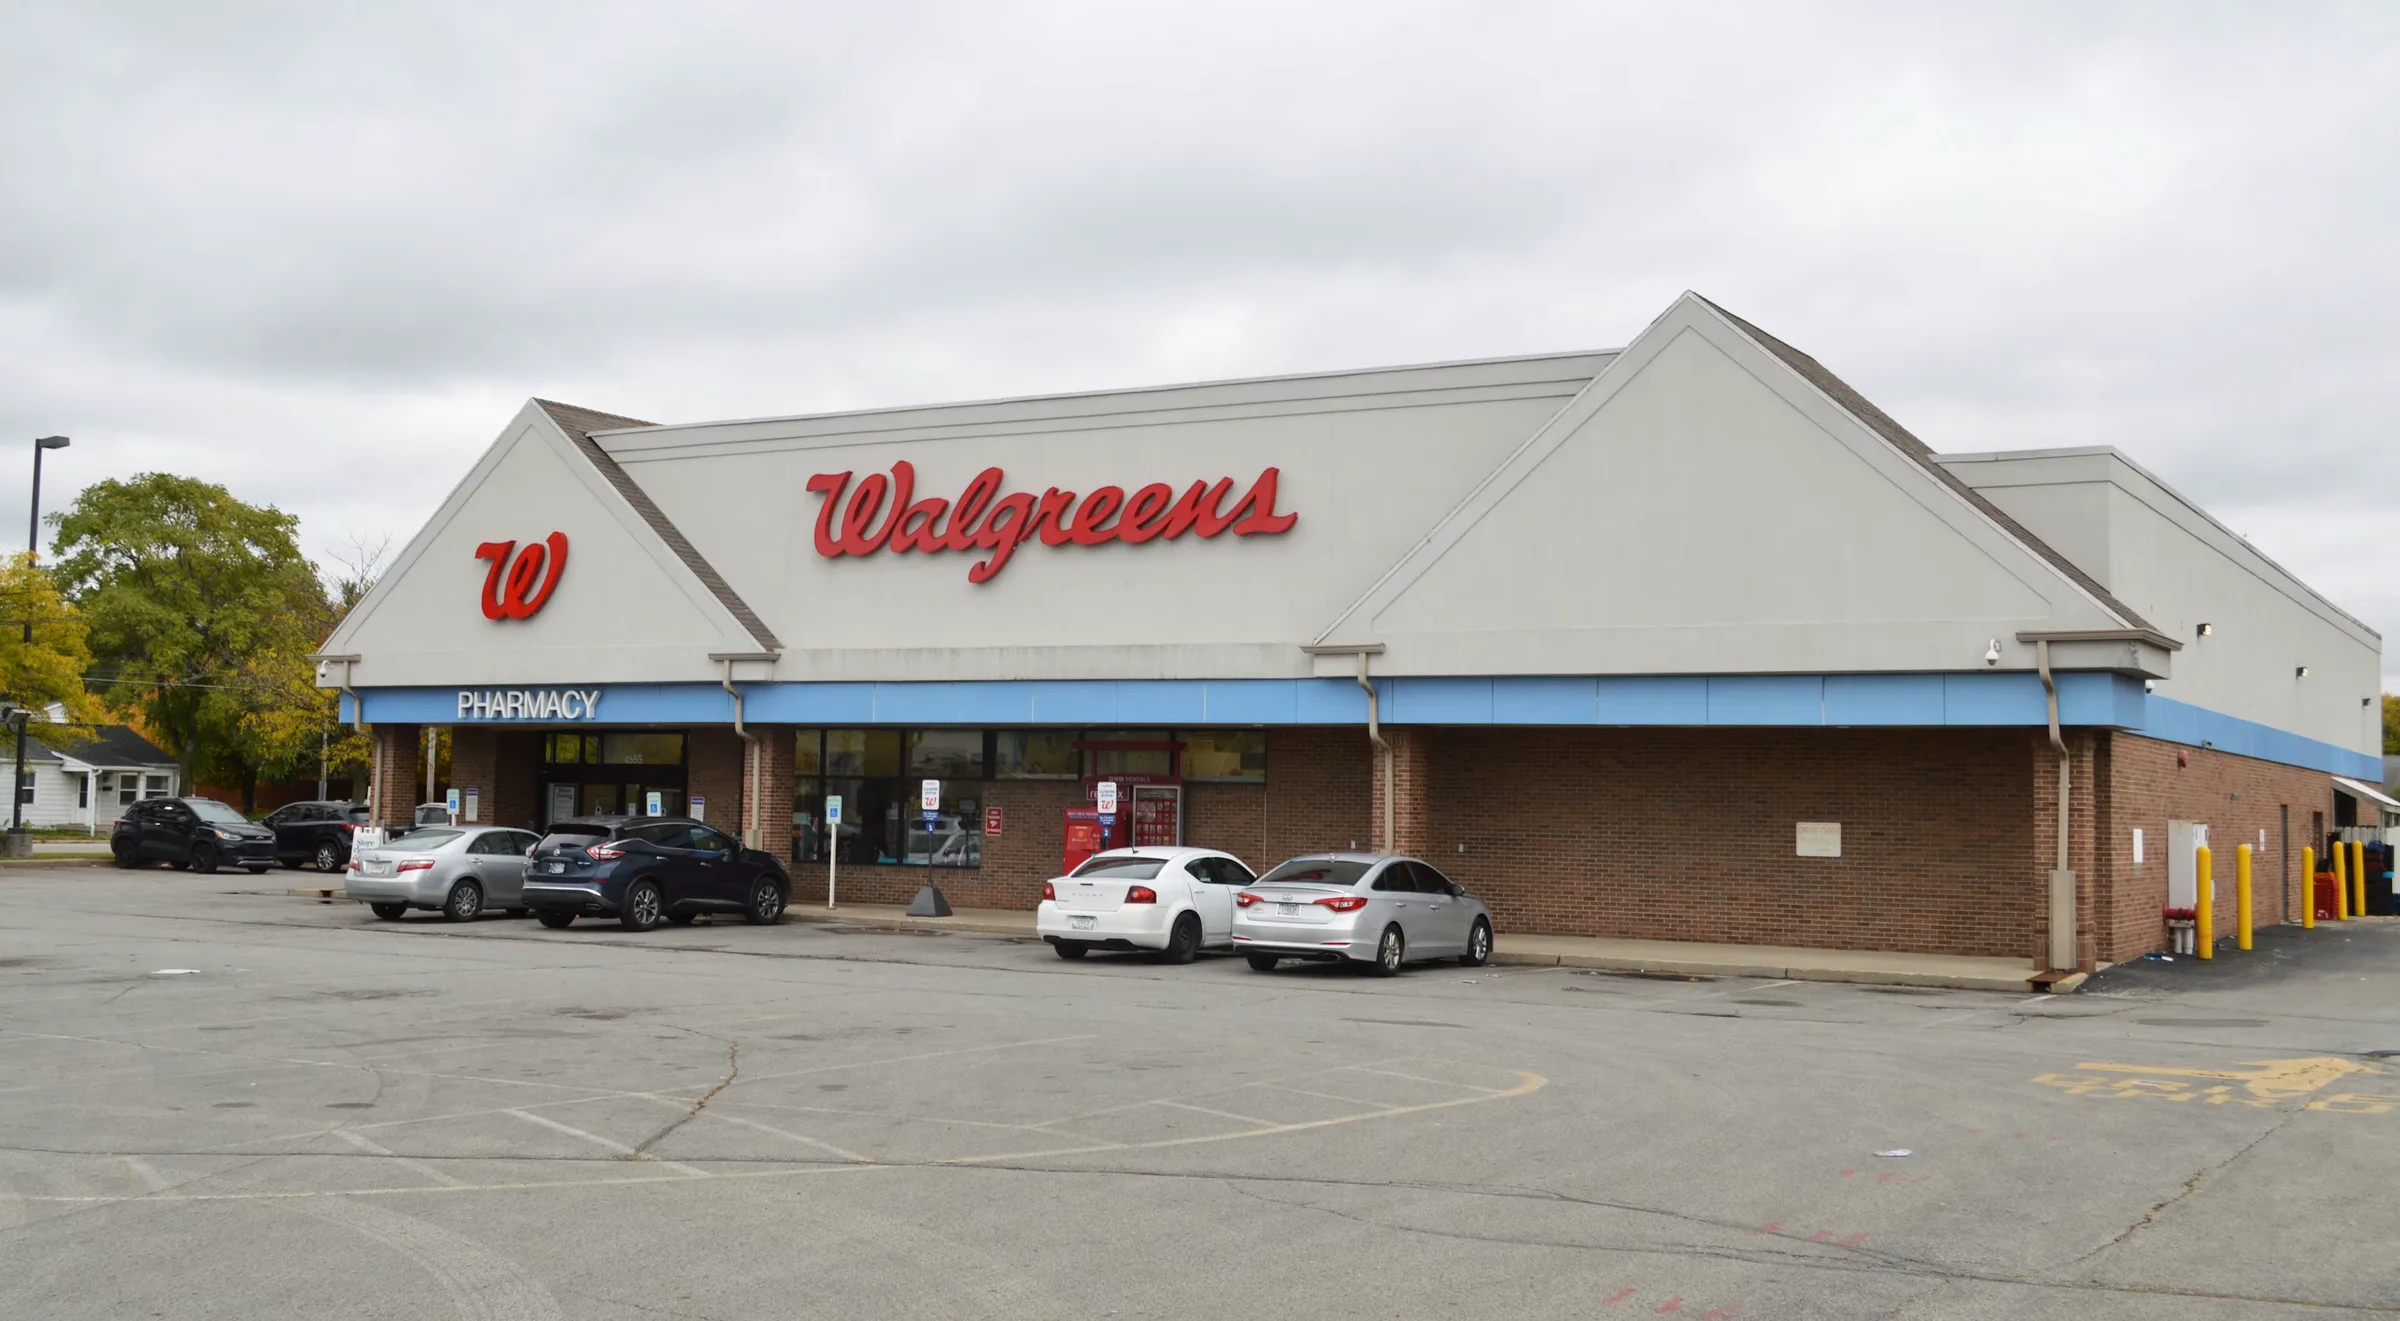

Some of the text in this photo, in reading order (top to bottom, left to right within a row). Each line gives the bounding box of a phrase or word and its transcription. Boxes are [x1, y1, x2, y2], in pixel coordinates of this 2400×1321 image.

[806, 460, 1298, 584] Walgreens
[475, 530, 568, 620] W
[457, 690, 602, 720] PHARMACY
[1090, 789, 1124, 799] rex
[1104, 828, 1109, 837] 2
